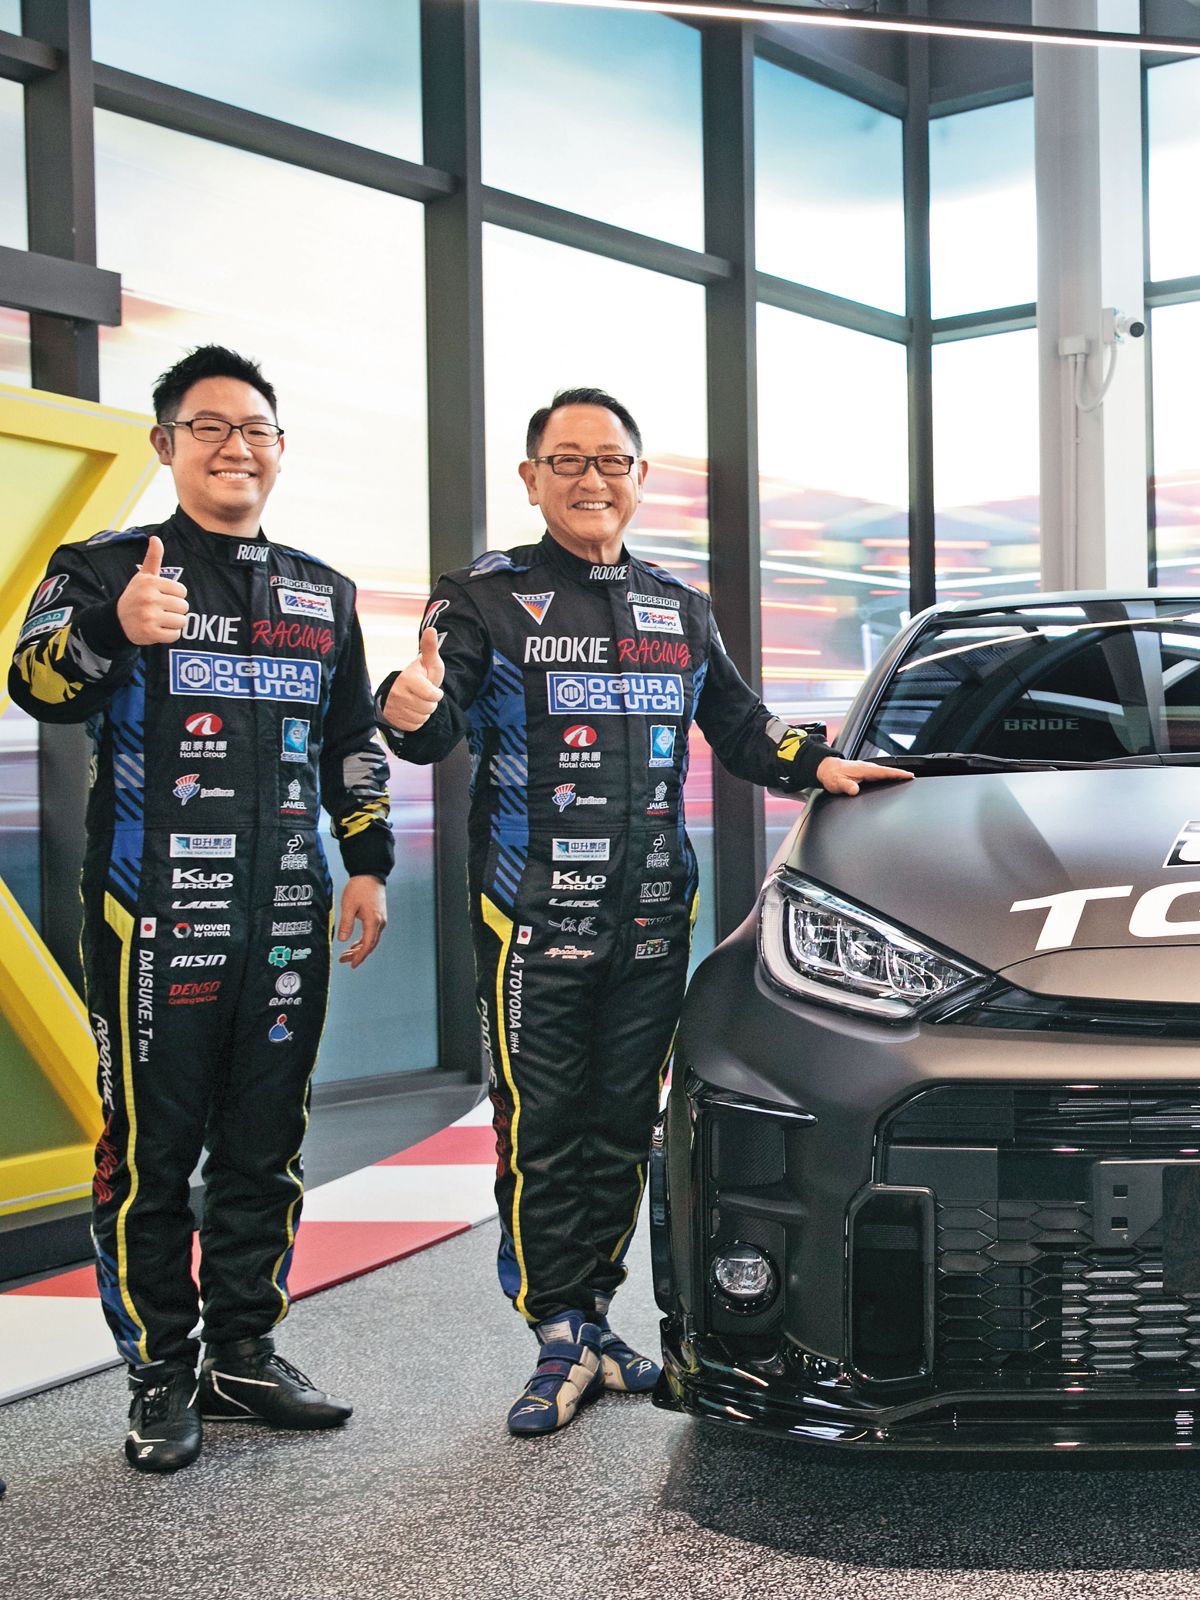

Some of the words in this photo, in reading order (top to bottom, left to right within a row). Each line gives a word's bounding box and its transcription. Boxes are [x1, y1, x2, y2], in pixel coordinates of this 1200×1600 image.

[236, 544, 270, 562] ROOKI
[589, 565, 628, 580] ROOKIE
[270, 576, 334, 594] BRIDGESTONE
[627, 592, 681, 609] BRIDGESTONE
[182, 612, 242, 645] OKIE
[252, 619, 335, 655] RACING
[524, 636, 610, 664] ROOKIE
[617, 637, 692, 668] RACING
[214, 659, 316, 681] OGURA
[215, 676, 315, 699] CLUTCH
[588, 678, 679, 695] OGURA
[589, 694, 680, 710] CLUTCH
[1004, 718, 1080, 731] BRIDE
[203, 751, 227, 759] Group
[171, 882, 234, 890] GROUP
[273, 884, 314, 902] KOD
[640, 881, 672, 898] KOD
[169, 954, 227, 968] AISIN
[169, 980, 222, 997] DENSO
[509, 952, 525, 1029] A.TOYODA
